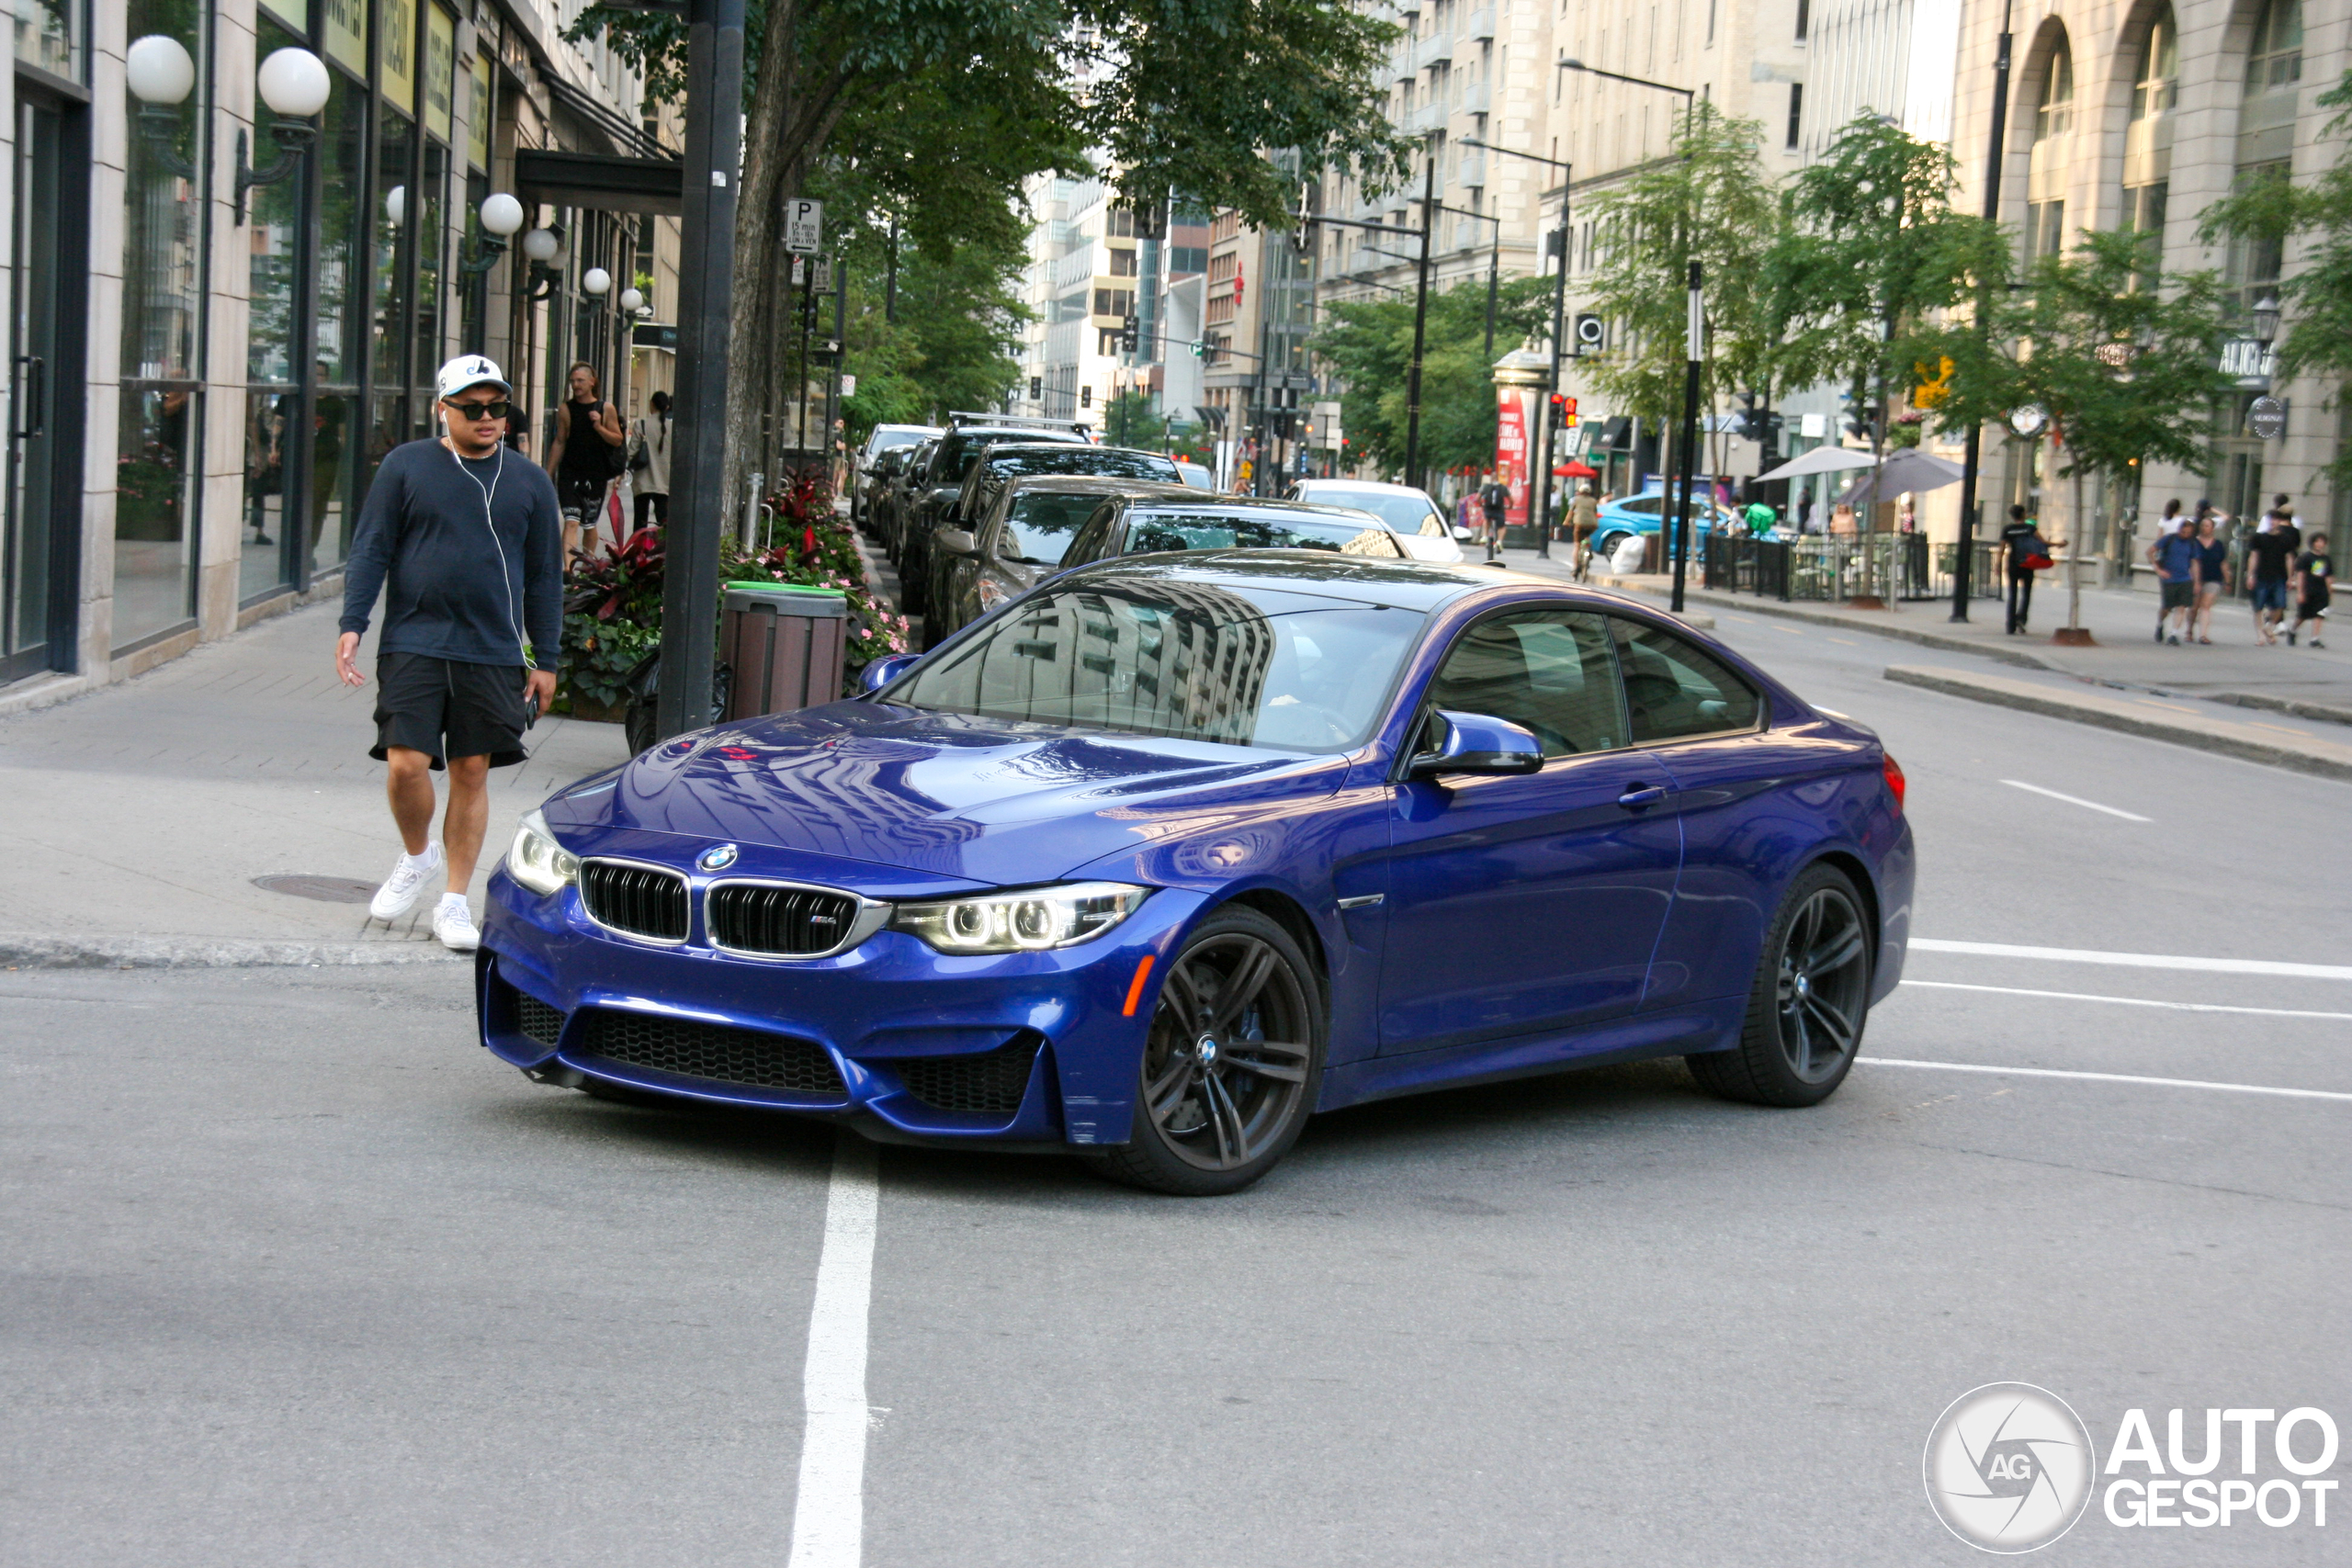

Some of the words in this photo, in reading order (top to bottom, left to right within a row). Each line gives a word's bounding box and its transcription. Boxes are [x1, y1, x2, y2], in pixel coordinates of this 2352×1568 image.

[798, 202, 811, 220] P
[792, 221, 799, 231] 15
[802, 223, 816, 231] min
